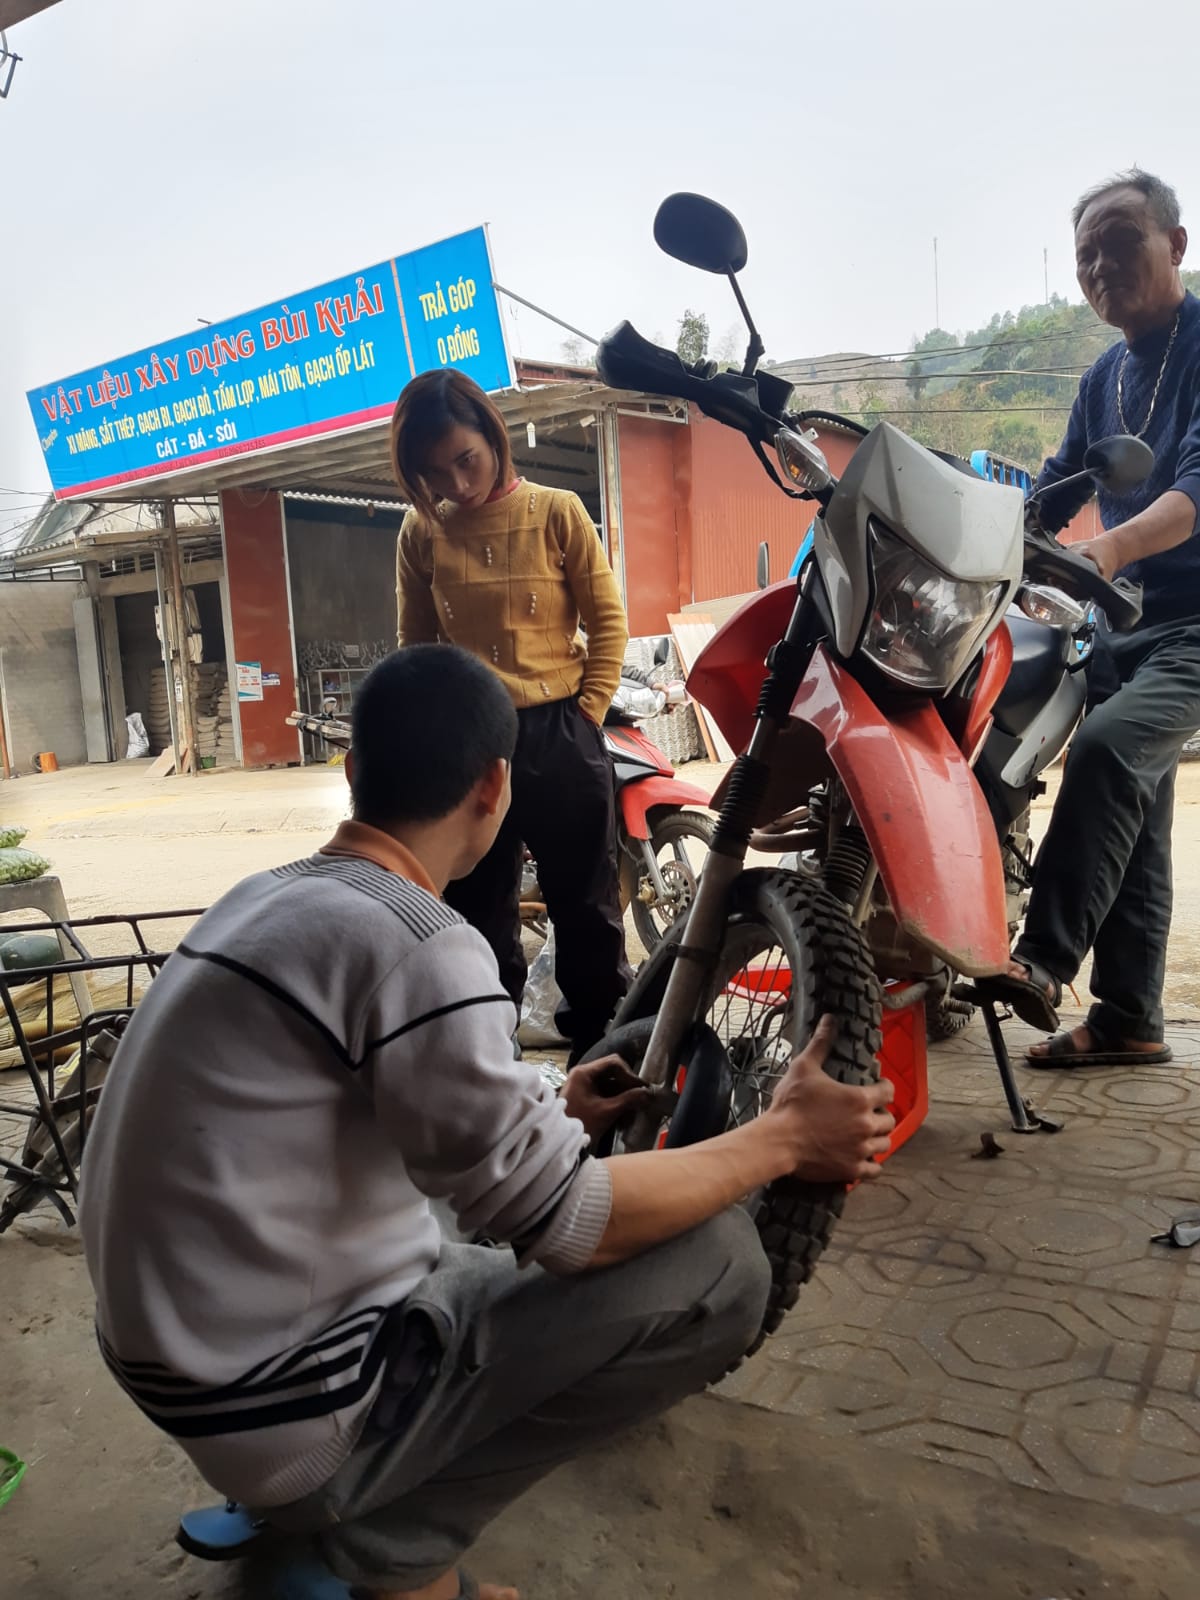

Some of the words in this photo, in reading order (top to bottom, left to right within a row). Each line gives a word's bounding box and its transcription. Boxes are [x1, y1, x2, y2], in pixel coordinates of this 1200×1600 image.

[418, 281, 448, 322] TRẢ
[448, 275, 476, 313] GÓP
[41, 386, 82, 424] VẬT
[86, 369, 132, 410] LIỆU
[134, 353, 179, 392] XÂY
[186, 333, 255, 377] DỰNG
[260, 305, 310, 351] BÙI
[314, 277, 384, 338] KHẢI
[446, 323, 480, 362] ĐỒNG
[66, 434, 78, 455] XI
[98, 416, 116, 446] SẮT
[137, 408, 162, 437] GẠCH
[159, 405, 175, 428] BI,
[172, 397, 199, 426] GẠCH
[197, 386, 215, 416] ĐỎ,
[212, 380, 237, 412] TẤM
[258, 368, 280, 400] MÁI
[278, 363, 306, 394] TÔN,
[304, 354, 336, 388] GẠCH
[335, 343, 352, 377] ỐP
[351, 338, 376, 372] LÁT
[155, 436, 179, 459] CÁT
[187, 427, 208, 451] ĐÁ
[215, 418, 238, 443] SỎI
